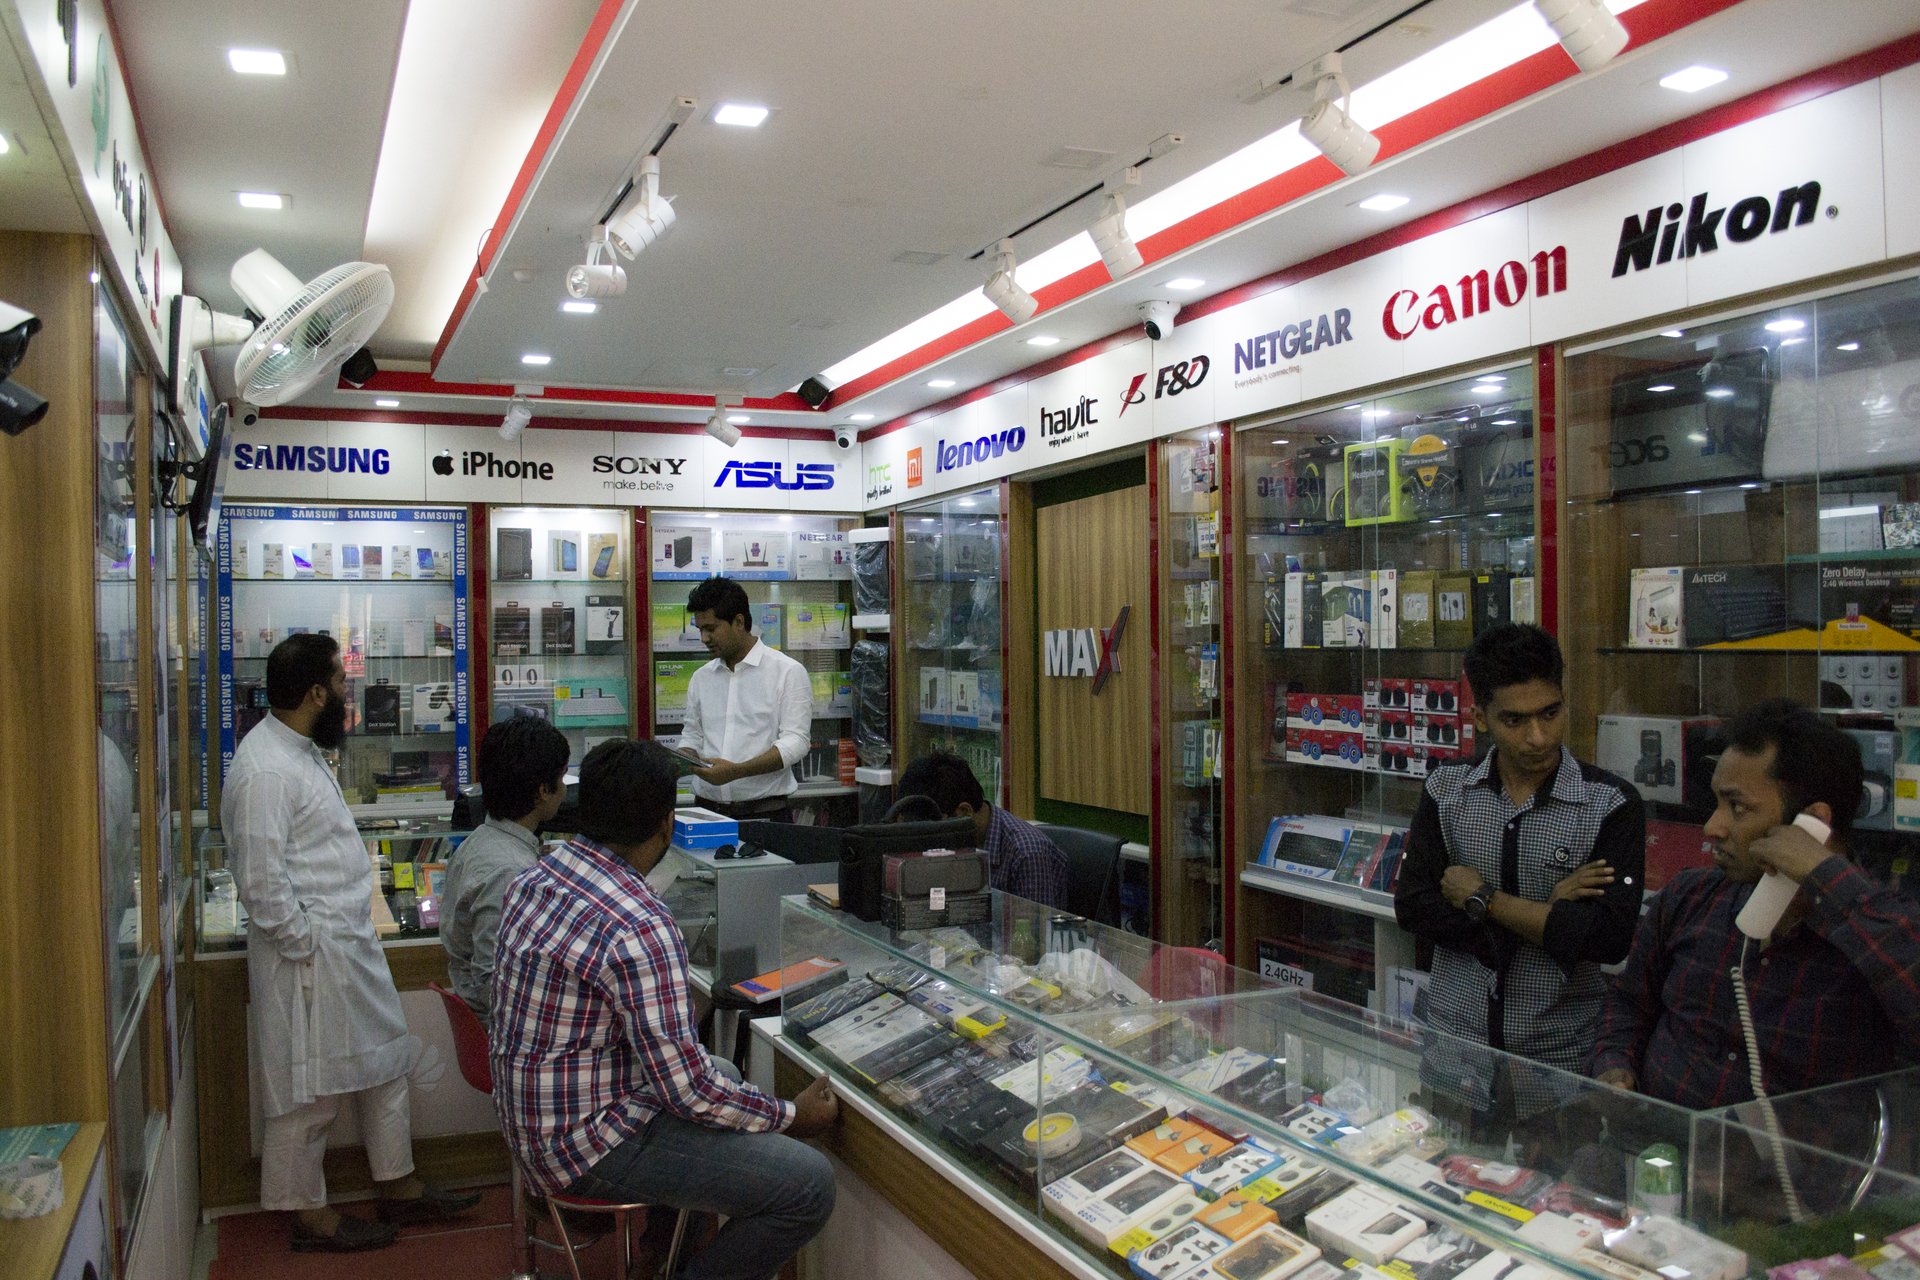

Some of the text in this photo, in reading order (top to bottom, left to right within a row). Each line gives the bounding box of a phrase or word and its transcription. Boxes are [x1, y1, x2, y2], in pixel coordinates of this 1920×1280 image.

[1611, 178, 1822, 279] Nikon
[1382, 244, 1567, 341] Canon
[1234, 307, 1353, 374] NETGEAR
[1154, 355, 1210, 399] F&D
[1041, 395, 1098, 437] havit
[234, 443, 390, 475] SAMSUNG
[462, 451, 554, 480] iPhone
[592, 455, 688, 475] SONY
[935, 425, 1026, 474] lenovo
[713, 460, 836, 491] ASUS
[869, 463, 892, 485] htc
[222, 508, 275, 517] SAMSUNG
[291, 509, 340, 518] SAMSUN
[347, 510, 398, 519] SAMSUNG
[413, 511, 463, 520] SAMSUNG
[219, 518, 229, 574] SAMSUNG
[456, 523, 465, 576] SAMSUNG
[799, 533, 843, 542] NETGEAR
[1822, 567, 1841, 578] Zero
[1842, 566, 1866, 578] Delay
[1865, 579, 1890, 587] Desktop
[220, 596, 231, 651] SAMSUNG
[457, 597, 466, 651] SAMSUNG
[1044, 603, 1133, 697] MAX
[221, 674, 232, 729] SAMSUNG
[457, 672, 467, 725] SAMSUNG
[1265, 963, 1304, 988] 2.4GHz
